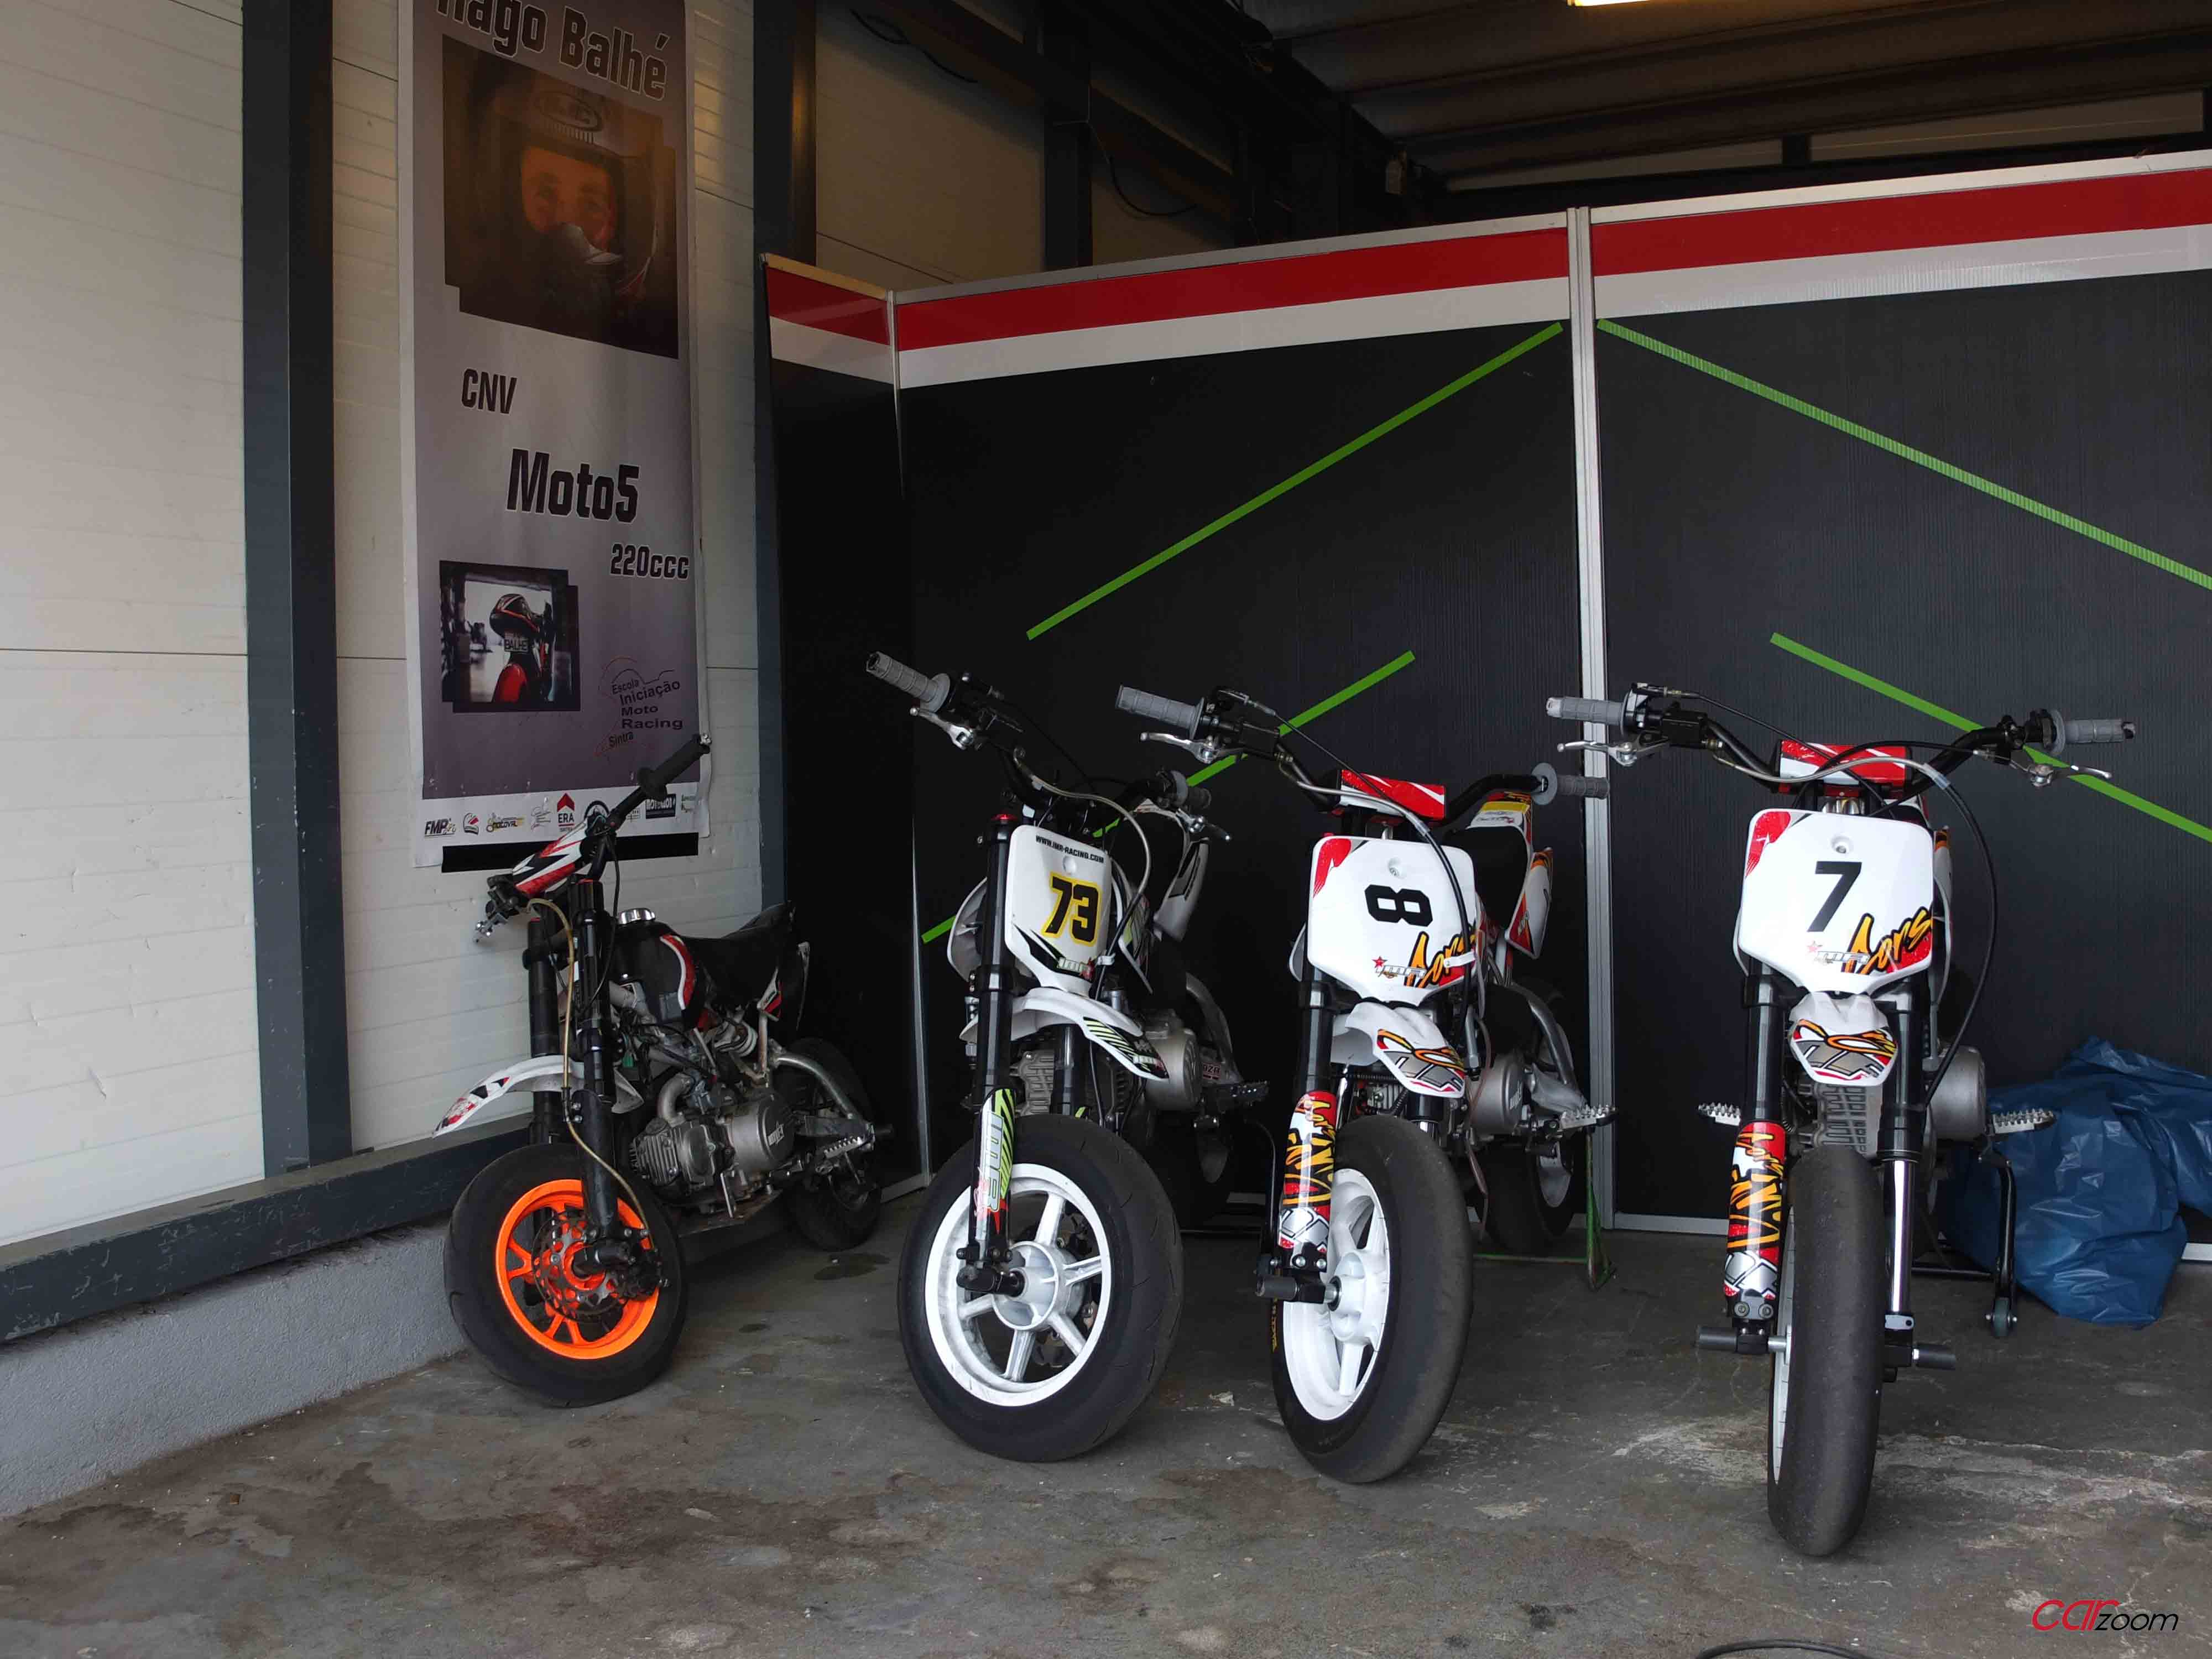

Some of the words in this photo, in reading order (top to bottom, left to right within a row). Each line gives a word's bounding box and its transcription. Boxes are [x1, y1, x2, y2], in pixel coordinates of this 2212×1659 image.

[436, 0, 547, 57] ago
[559, 6, 670, 101] Balhé
[461, 367, 518, 415] CNV
[505, 448, 640, 524] Moto5
[610, 542, 690, 580] 220ccc
[612, 679, 639, 695] Escola
[619, 681, 681, 705] Iniciação
[621, 705, 659, 716] Moto
[622, 718, 683, 730] Racing
[609, 731, 634, 748] Sintra
[424, 818, 449, 835] FMP
[557, 813, 575, 823] ERA
[1042, 873, 1100, 945] 73
[1364, 884, 1433, 927] 8
[1806, 860, 1863, 933] 7
